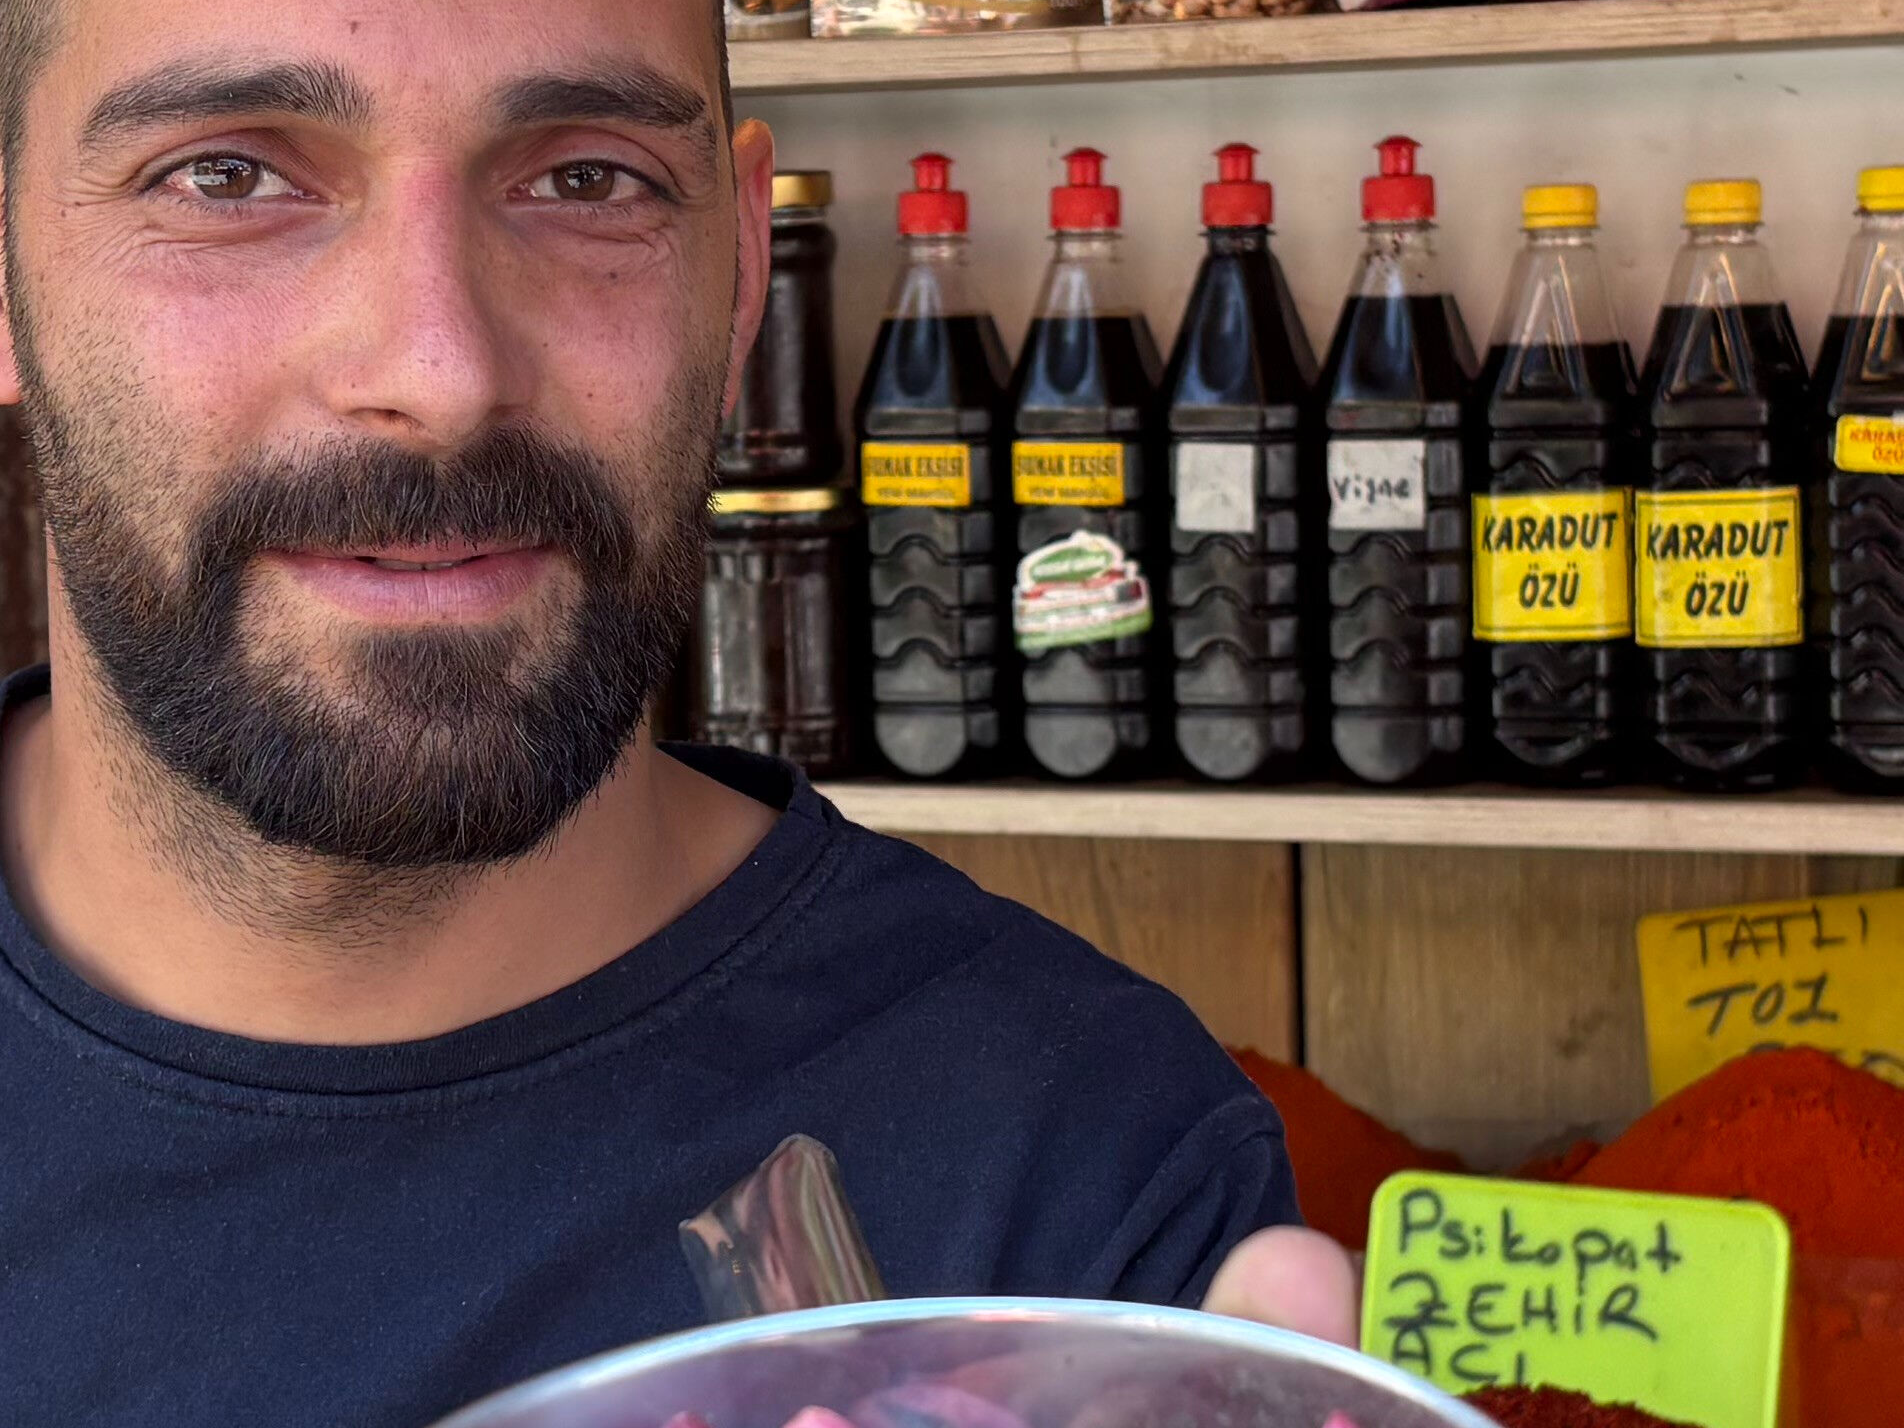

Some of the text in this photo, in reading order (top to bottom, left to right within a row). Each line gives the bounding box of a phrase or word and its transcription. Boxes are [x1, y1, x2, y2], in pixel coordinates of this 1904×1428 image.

[1480, 512, 1619, 554] KARADUT
[1645, 518, 1791, 562] KARADUT
[1518, 561, 1580, 611] ÖZÜ
[1684, 571, 1750, 618] ÖZÜ
[1674, 904, 1872, 966] TATLI
[1398, 1186, 1684, 1294] Psikopat
